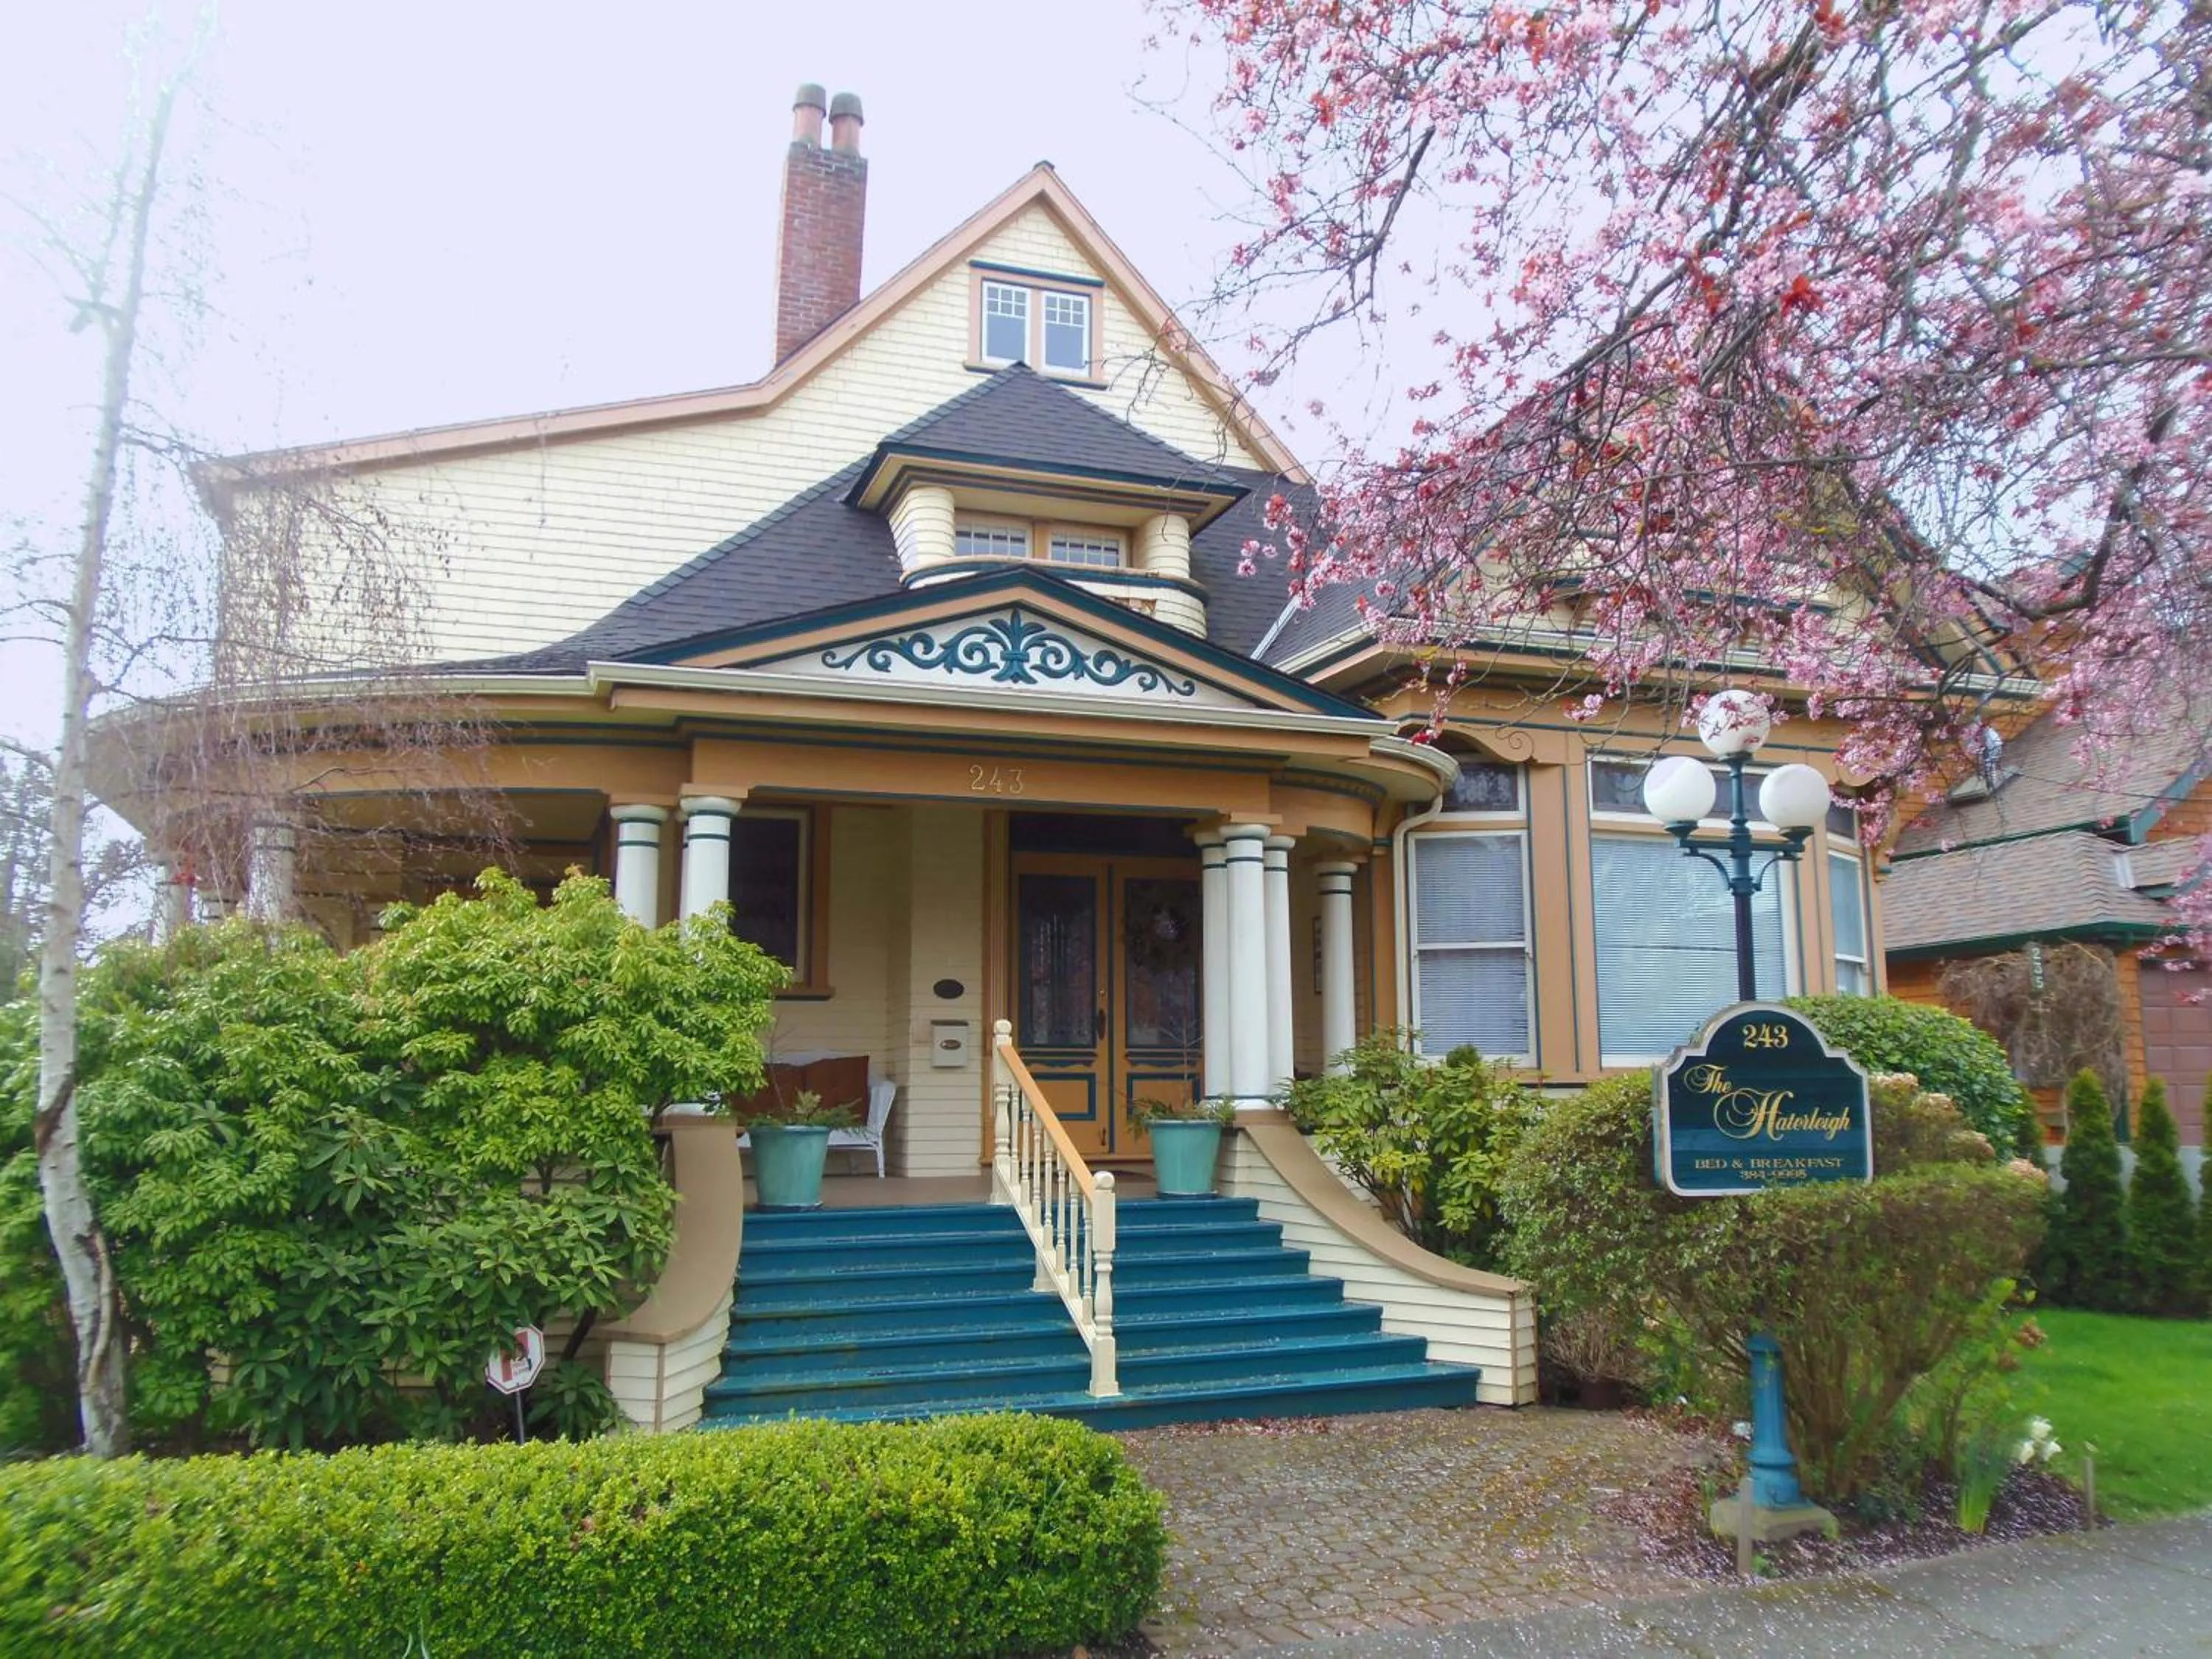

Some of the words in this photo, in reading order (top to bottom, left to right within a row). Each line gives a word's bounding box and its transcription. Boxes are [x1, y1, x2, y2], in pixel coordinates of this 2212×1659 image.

[970, 765, 1026, 794] 243
[1742, 1024, 1788, 1048] 243
[1684, 1064, 1732, 1094] The
[1714, 1088, 1851, 1141] Haterleigh
[1695, 1158, 1727, 1169] BED
[1732, 1158, 1742, 1169] &
[1750, 1158, 1843, 1169] BREAKFAST
